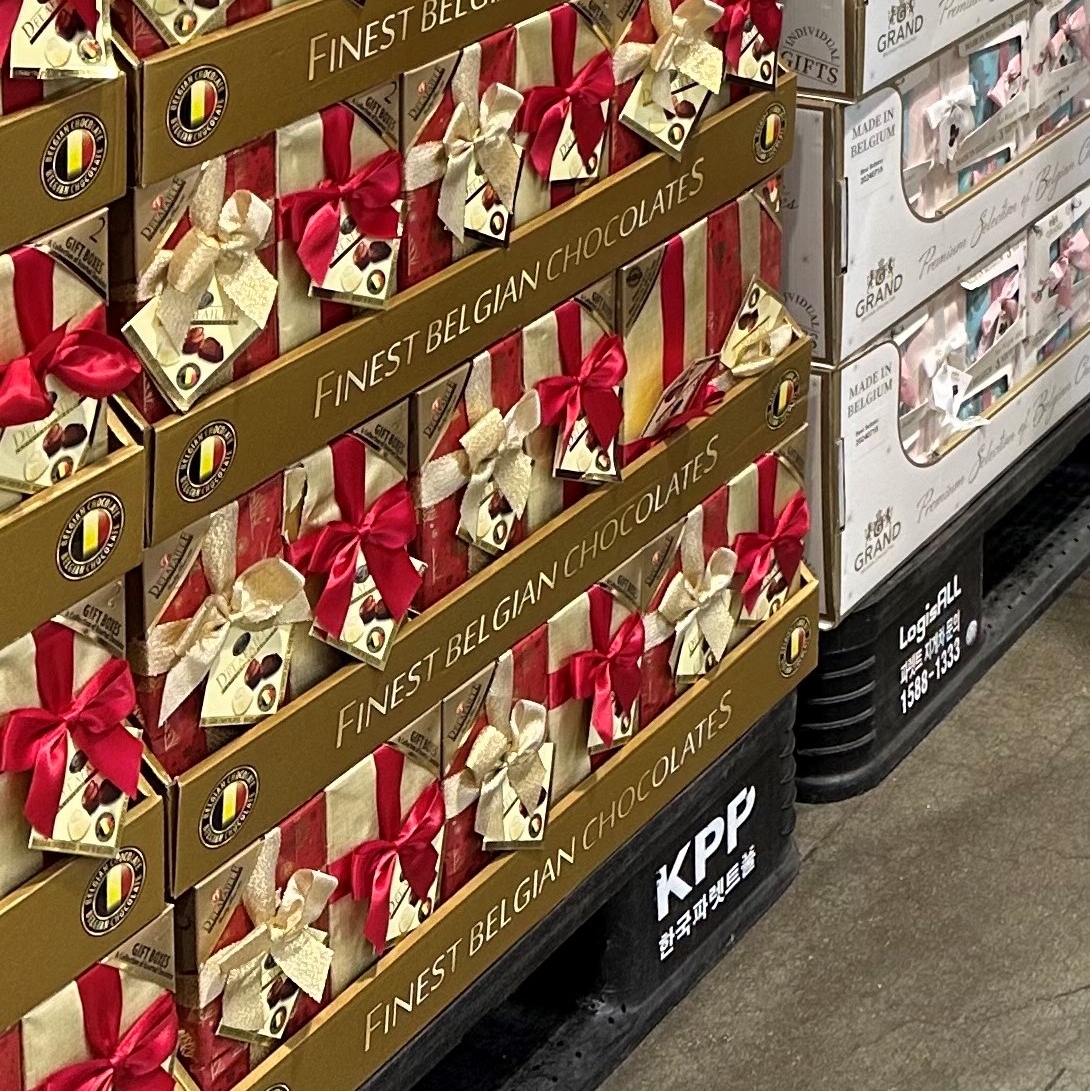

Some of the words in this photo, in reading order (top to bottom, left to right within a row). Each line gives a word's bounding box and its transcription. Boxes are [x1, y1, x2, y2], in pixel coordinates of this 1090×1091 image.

[308, 6, 417, 81] FINEST
[785, 25, 840, 61] INDIVIDUAL
[877, 15, 924, 52] GRAND
[781, 50, 839, 85] GIFTS
[850, 124, 895, 158] BELGIUM
[852, 114, 882, 140] MADE
[883, 108, 894, 124] IN
[90, 218, 105, 243] 2
[65, 236, 84, 257] GIFT
[82, 249, 103, 274] BOXES
[918, 238, 967, 280] Premium
[314, 334, 421, 418] FINEST
[426, 261, 540, 354] BELGIAN
[546, 157, 705, 281] CHOCOLATES
[855, 274, 902, 318] GRAND
[847, 378, 893, 418] BELGIUM
[849, 370, 879, 398] MADE
[880, 362, 892, 378] IN
[916, 474, 965, 523] Premium
[854, 521, 901, 571] GRAND
[336, 651, 440, 748] FINEST
[446, 561, 558, 668] BELGIAN
[564, 435, 719, 578] CHOCOLATES
[900, 574, 962, 650] LogisALL
[900, 637, 960, 714] 1588-1333
[364, 939, 462, 1052] FINEST
[468, 837, 576, 957] BELGIAN
[583, 689, 733, 850] CHOCOLATES
[655, 785, 756, 922] KPP
[658, 844, 757, 960] 한국파렛트풀
